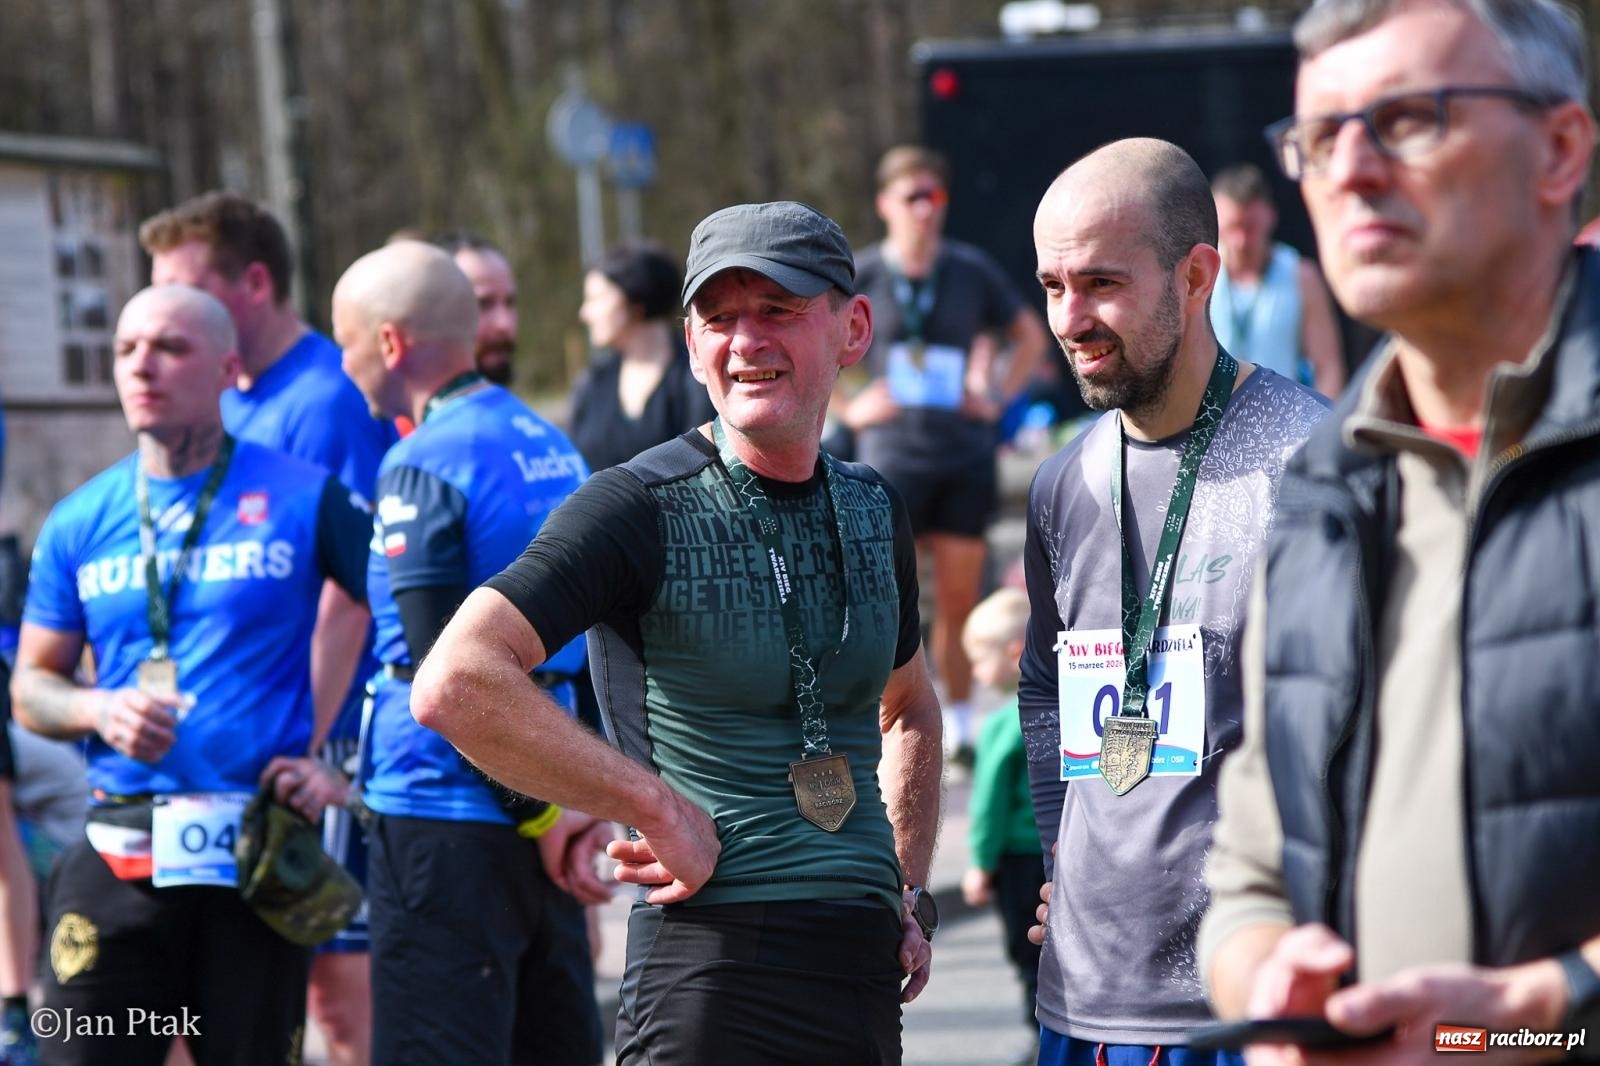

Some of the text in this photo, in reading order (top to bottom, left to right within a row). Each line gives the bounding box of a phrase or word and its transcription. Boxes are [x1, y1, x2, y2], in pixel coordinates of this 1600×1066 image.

[512, 447, 588, 483] Lucky
[768, 547, 787, 605] TWARDZIELA
[777, 555, 792, 594] XIV BIEG
[1069, 638, 1193, 656] XIV BIEG ARDZIELA
[1069, 662, 1076, 670] 15
[1092, 682, 1172, 738] 01
